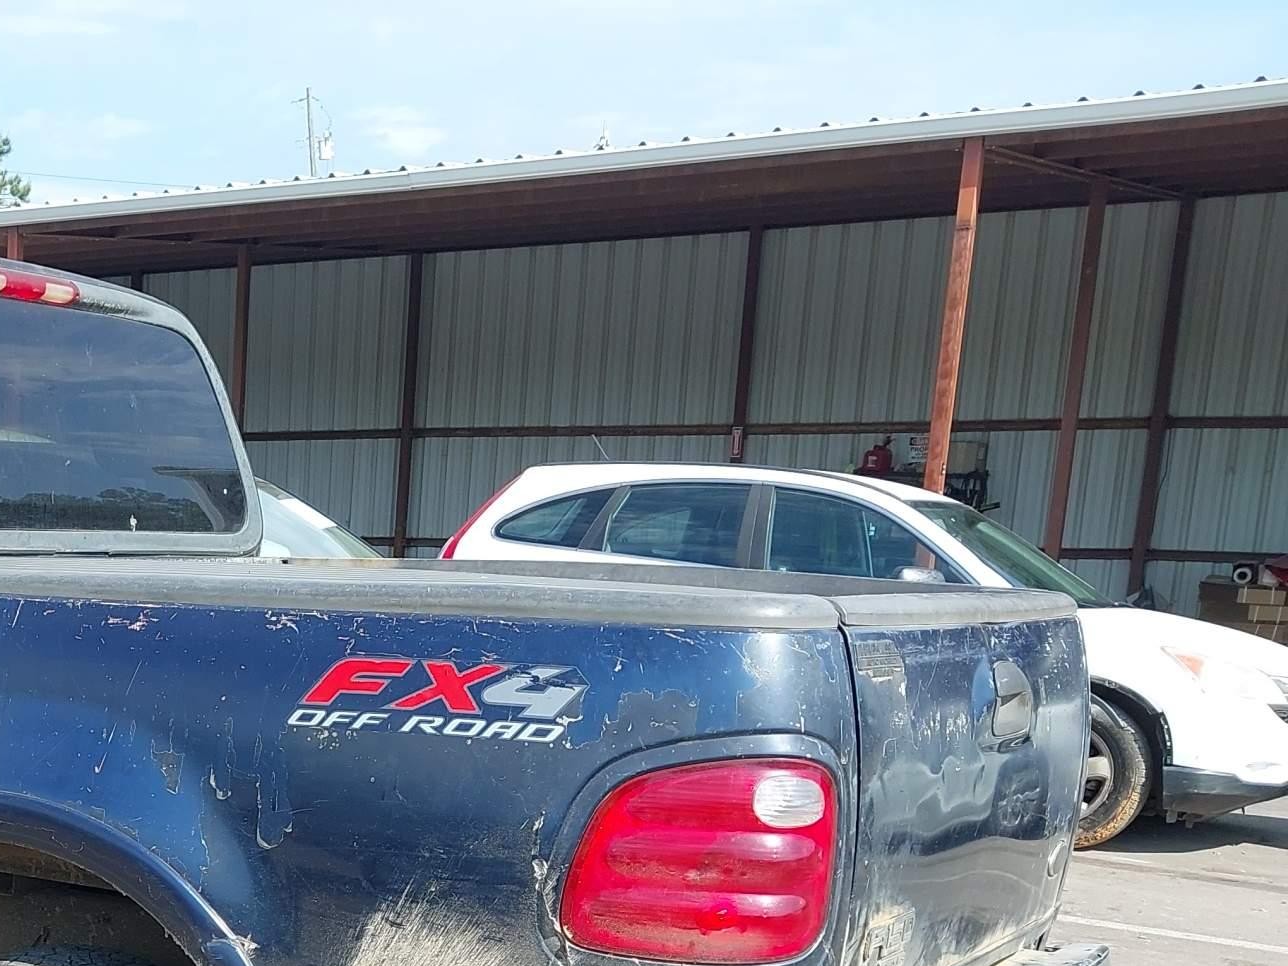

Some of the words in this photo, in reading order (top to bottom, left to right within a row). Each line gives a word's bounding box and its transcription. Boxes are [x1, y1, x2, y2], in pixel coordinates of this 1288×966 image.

[298, 657, 591, 720] FX4
[287, 709, 393, 731] OFF
[398, 715, 566, 744] ROAD
